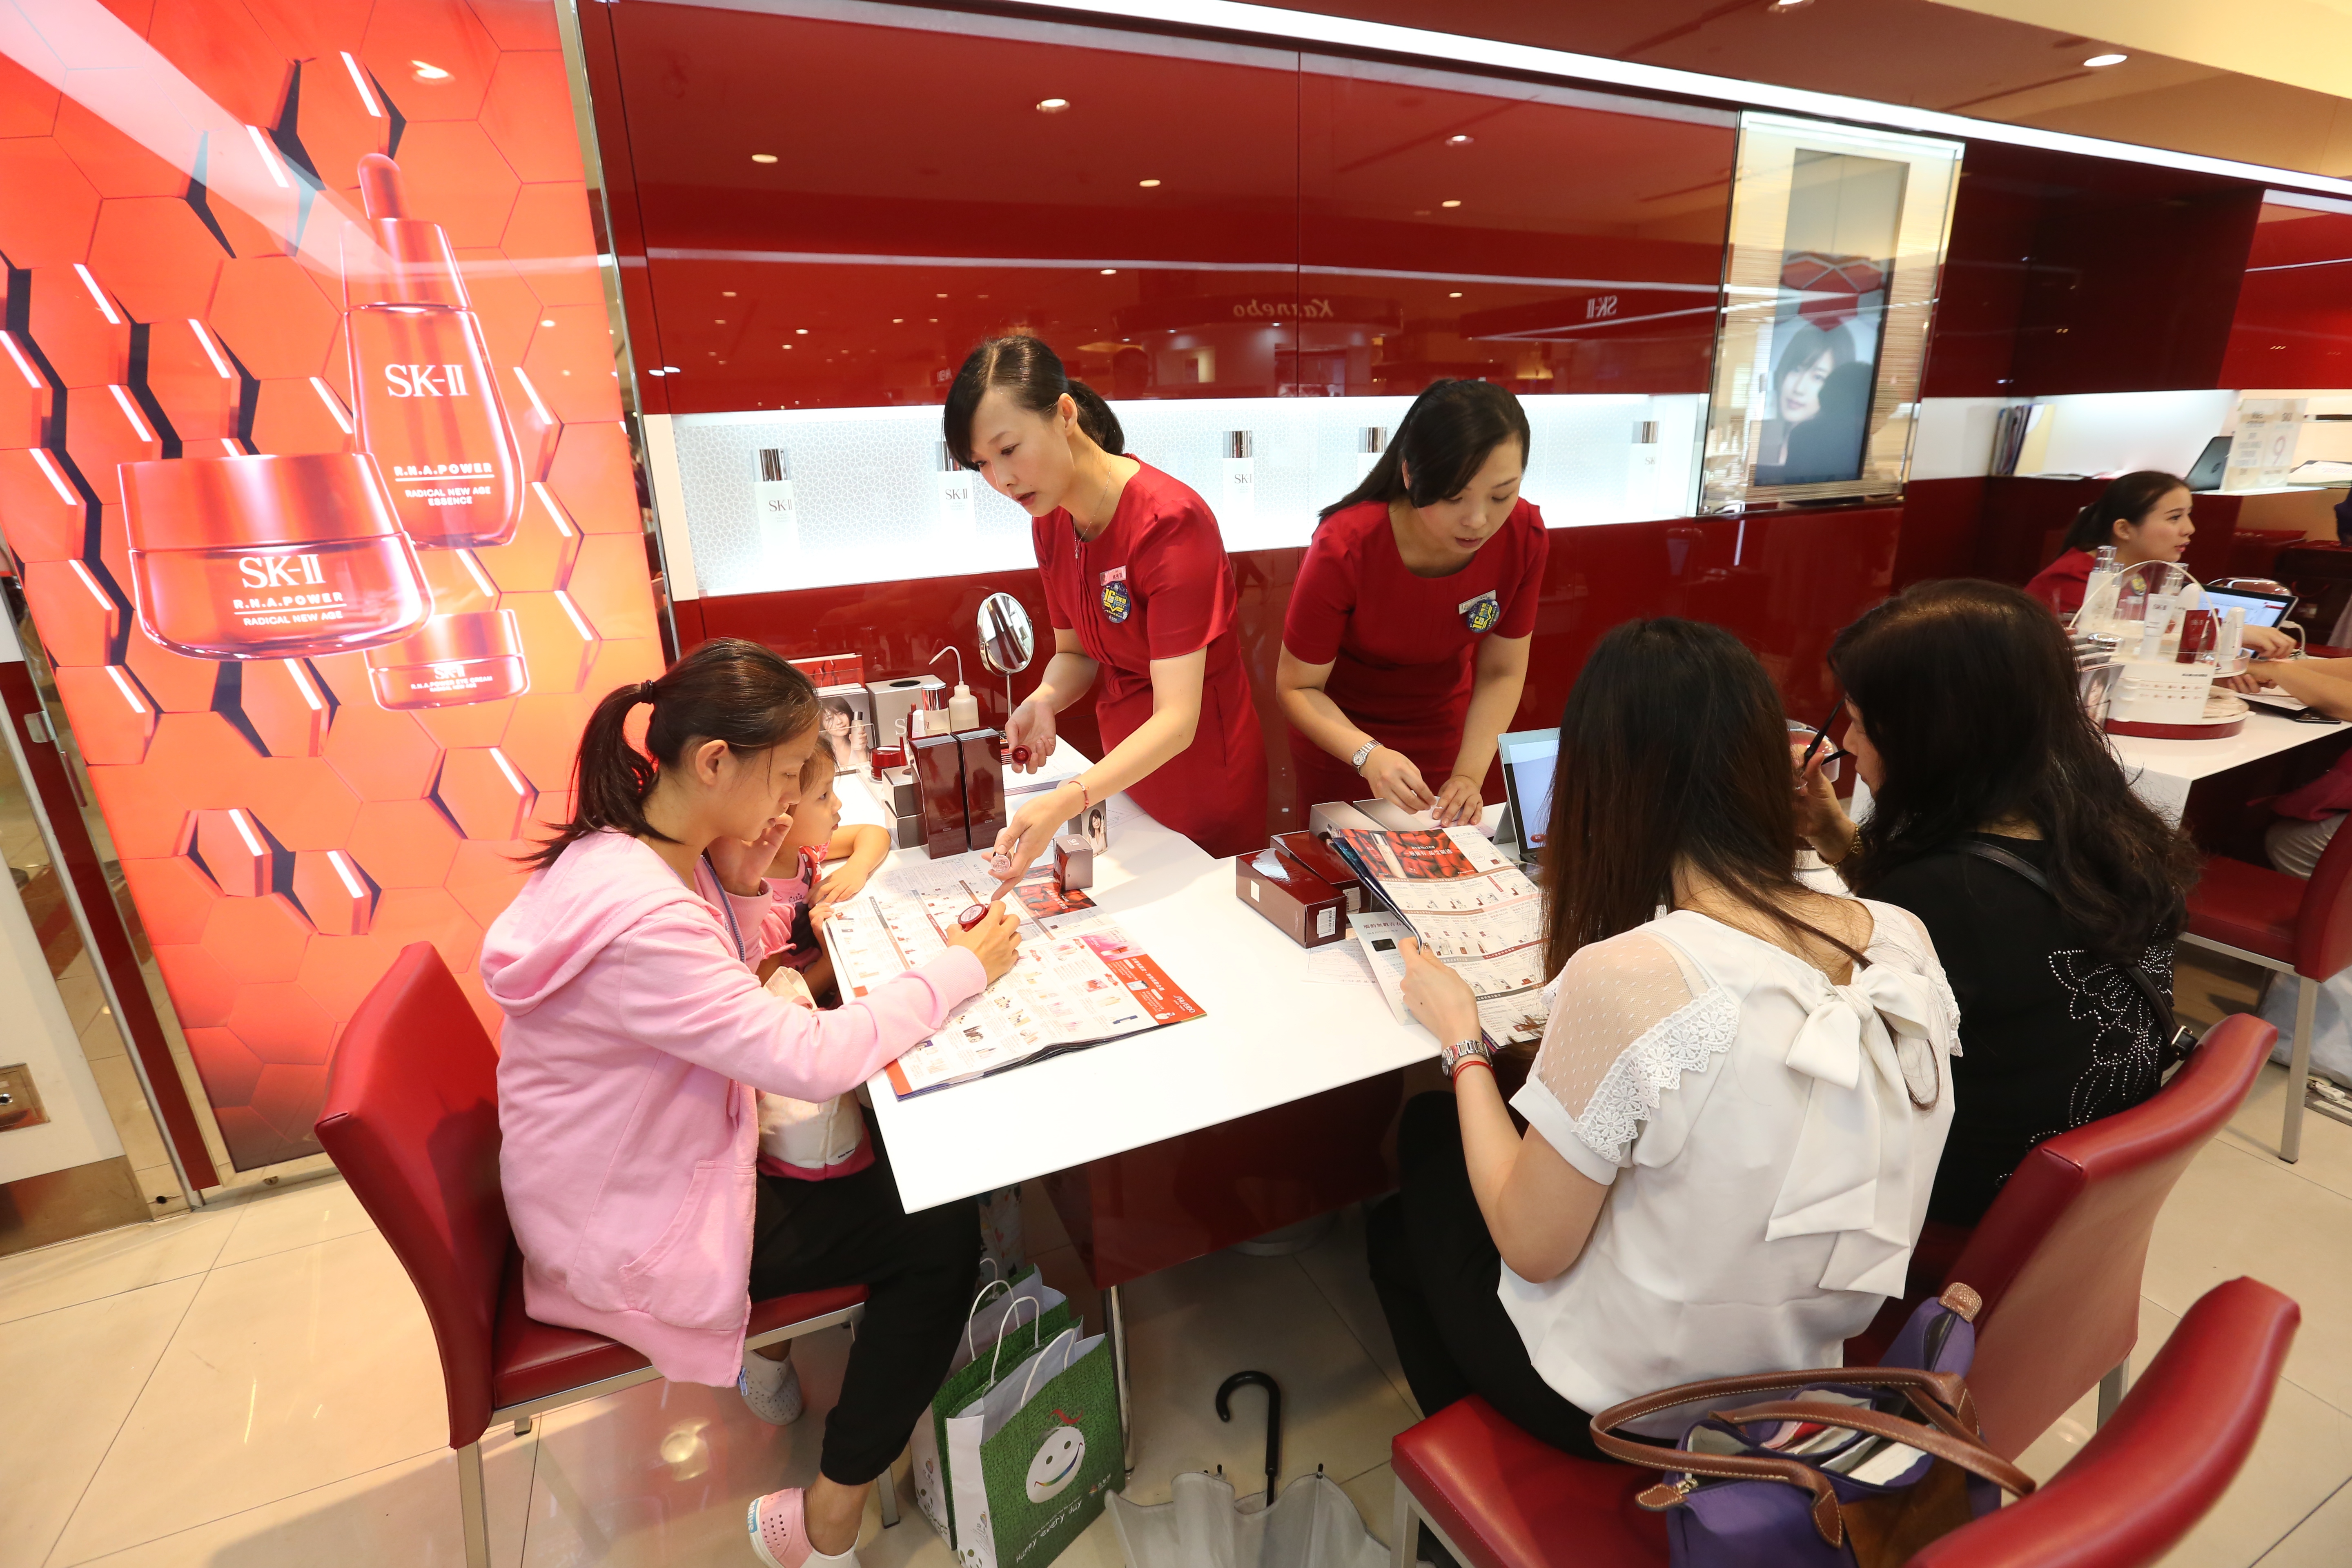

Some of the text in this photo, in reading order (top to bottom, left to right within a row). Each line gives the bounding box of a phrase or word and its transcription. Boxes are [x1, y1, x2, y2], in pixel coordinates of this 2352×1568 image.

[385, 364, 469, 397] SK-II
[394, 463, 492, 476] R.N.A.POWER
[405, 486, 491, 498] RADICAL NEW AGE
[945, 488, 968, 500] SK-II
[428, 496, 472, 506] ESSENCE
[769, 499, 793, 512] SK-II
[239, 554, 326, 588] SK-II
[233, 592, 343, 609] R.N.A.POWER
[243, 610, 343, 626] RADICAL NEW AGE
[1173, 995, 1196, 1013] SHISEIDO
[1040, 1513, 1065, 1537] every
